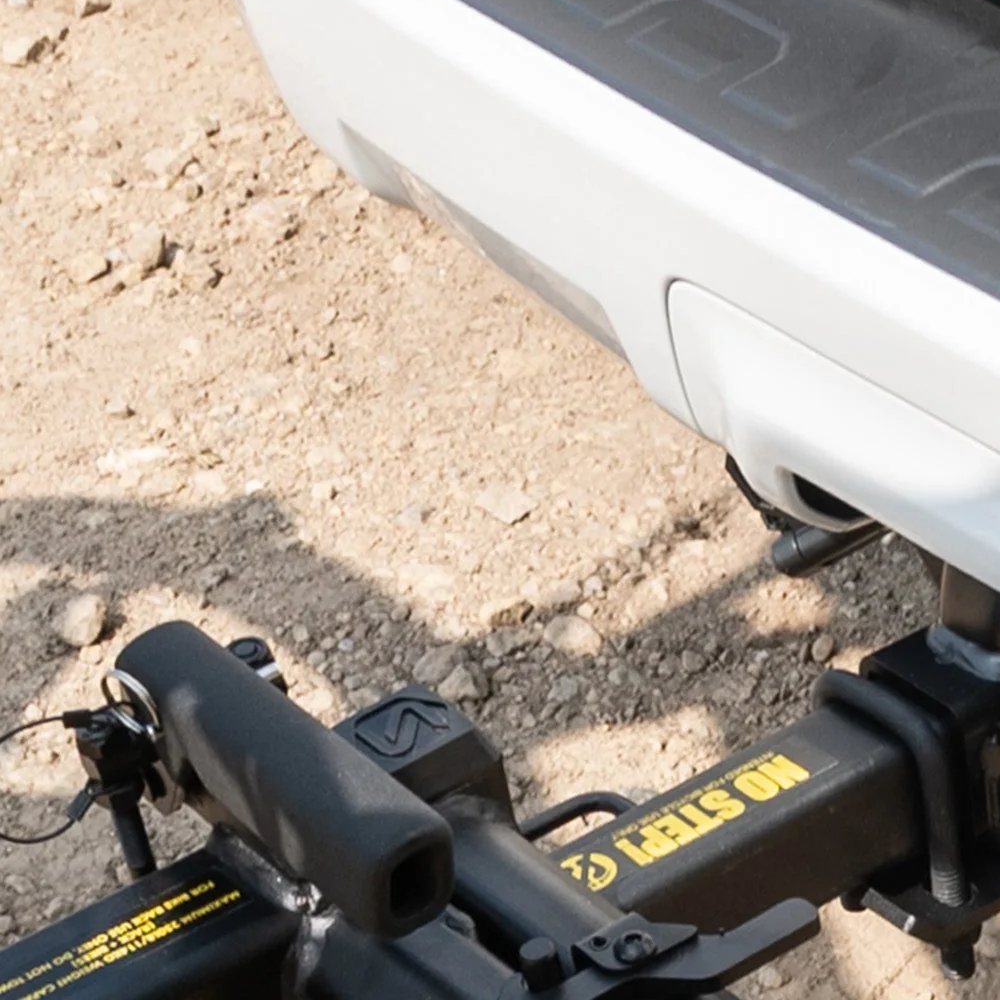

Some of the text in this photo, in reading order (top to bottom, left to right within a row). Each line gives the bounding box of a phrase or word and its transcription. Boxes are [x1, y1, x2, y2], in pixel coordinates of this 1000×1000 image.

[614, 754, 810, 867] NO STEP!
[189, 879, 214, 896] FOR
[52, 951, 73, 965] DO
[25, 962, 52, 979] NOT
[56, 959, 103, 986] WEIGHT
